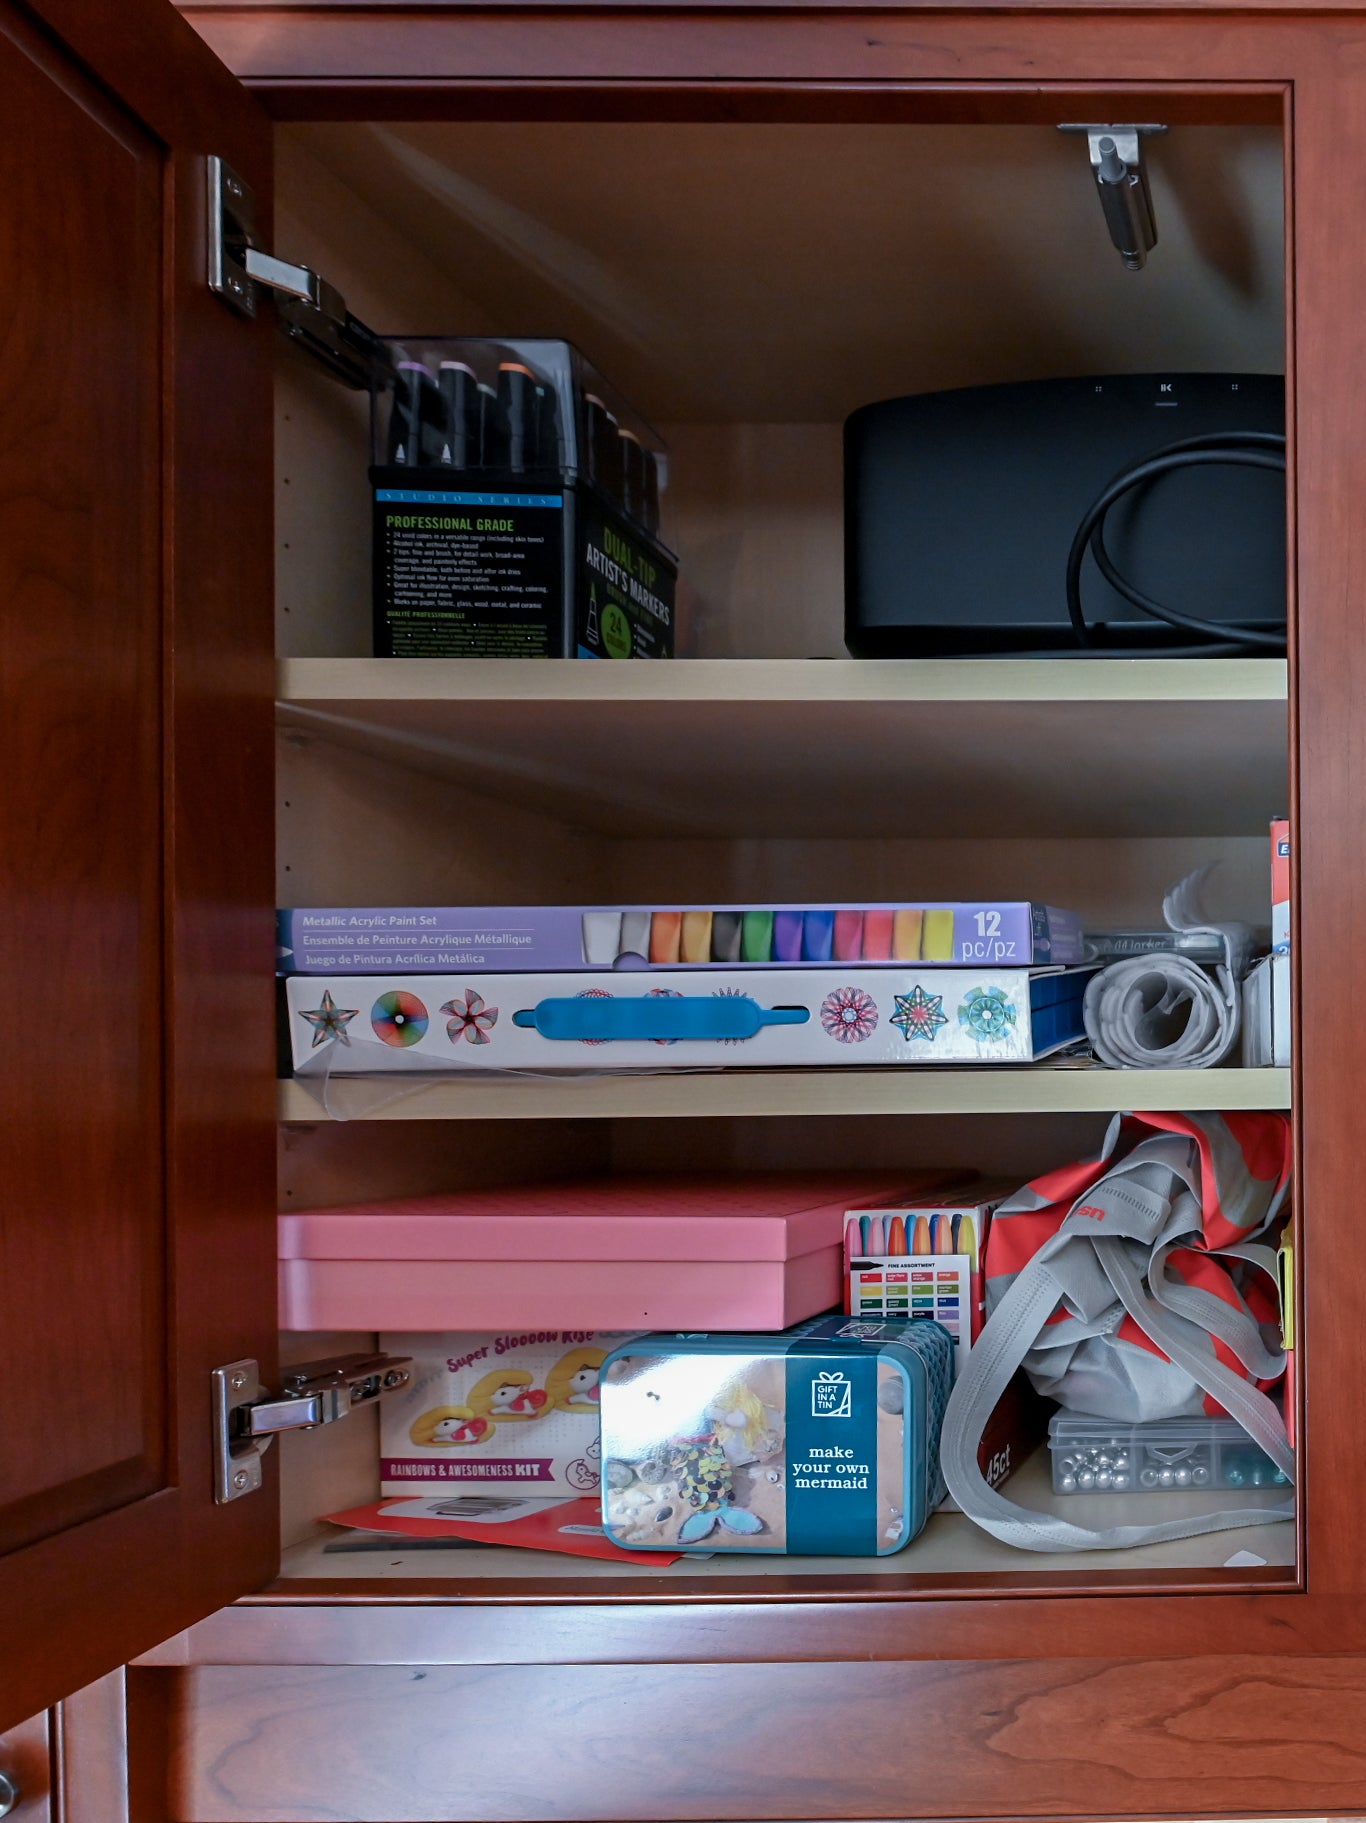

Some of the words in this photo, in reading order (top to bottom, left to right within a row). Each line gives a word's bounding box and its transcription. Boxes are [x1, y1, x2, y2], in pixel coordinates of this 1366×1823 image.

[386, 515, 473, 530] PROFESSIONAL
[476, 518, 514, 532] GRADE
[604, 526, 656, 589] DUAL-TIP
[586, 543, 628, 592] ARTIST'S
[630, 578, 670, 626] MARKERS
[610, 612, 622, 634] 24
[302, 916, 346, 926] Metallic
[349, 916, 386, 928] Acrylic
[390, 916, 416, 926] Paint
[420, 916, 437, 925] Set
[973, 911, 1001, 937] 12
[303, 936, 354, 945] Ensemble
[357, 935, 369, 945] de
[373, 935, 417, 945] Peinture
[420, 934, 472, 947] Acrylique
[475, 934, 532, 946] Métallique
[962, 938, 1016, 962] pc/pz
[306, 954, 336, 966] Juego
[339, 954, 351, 964] de
[354, 954, 392, 964] Pintura
[395, 953, 435, 963] Acrílica
[438, 953, 484, 963] Metálica
[446, 1347, 489, 1372] Super
[809, 1446, 854, 1458] make
[391, 1464, 436, 1476] RAINBOWS
[439, 1464, 447, 1476] &
[448, 1464, 514, 1476] AWESOMENESS
[515, 1464, 540, 1476] KIT
[792, 1463, 831, 1476] your
[836, 1464, 870, 1474] own
[986, 1443, 1010, 1486] 45ct
[795, 1477, 868, 1489] mermaid
